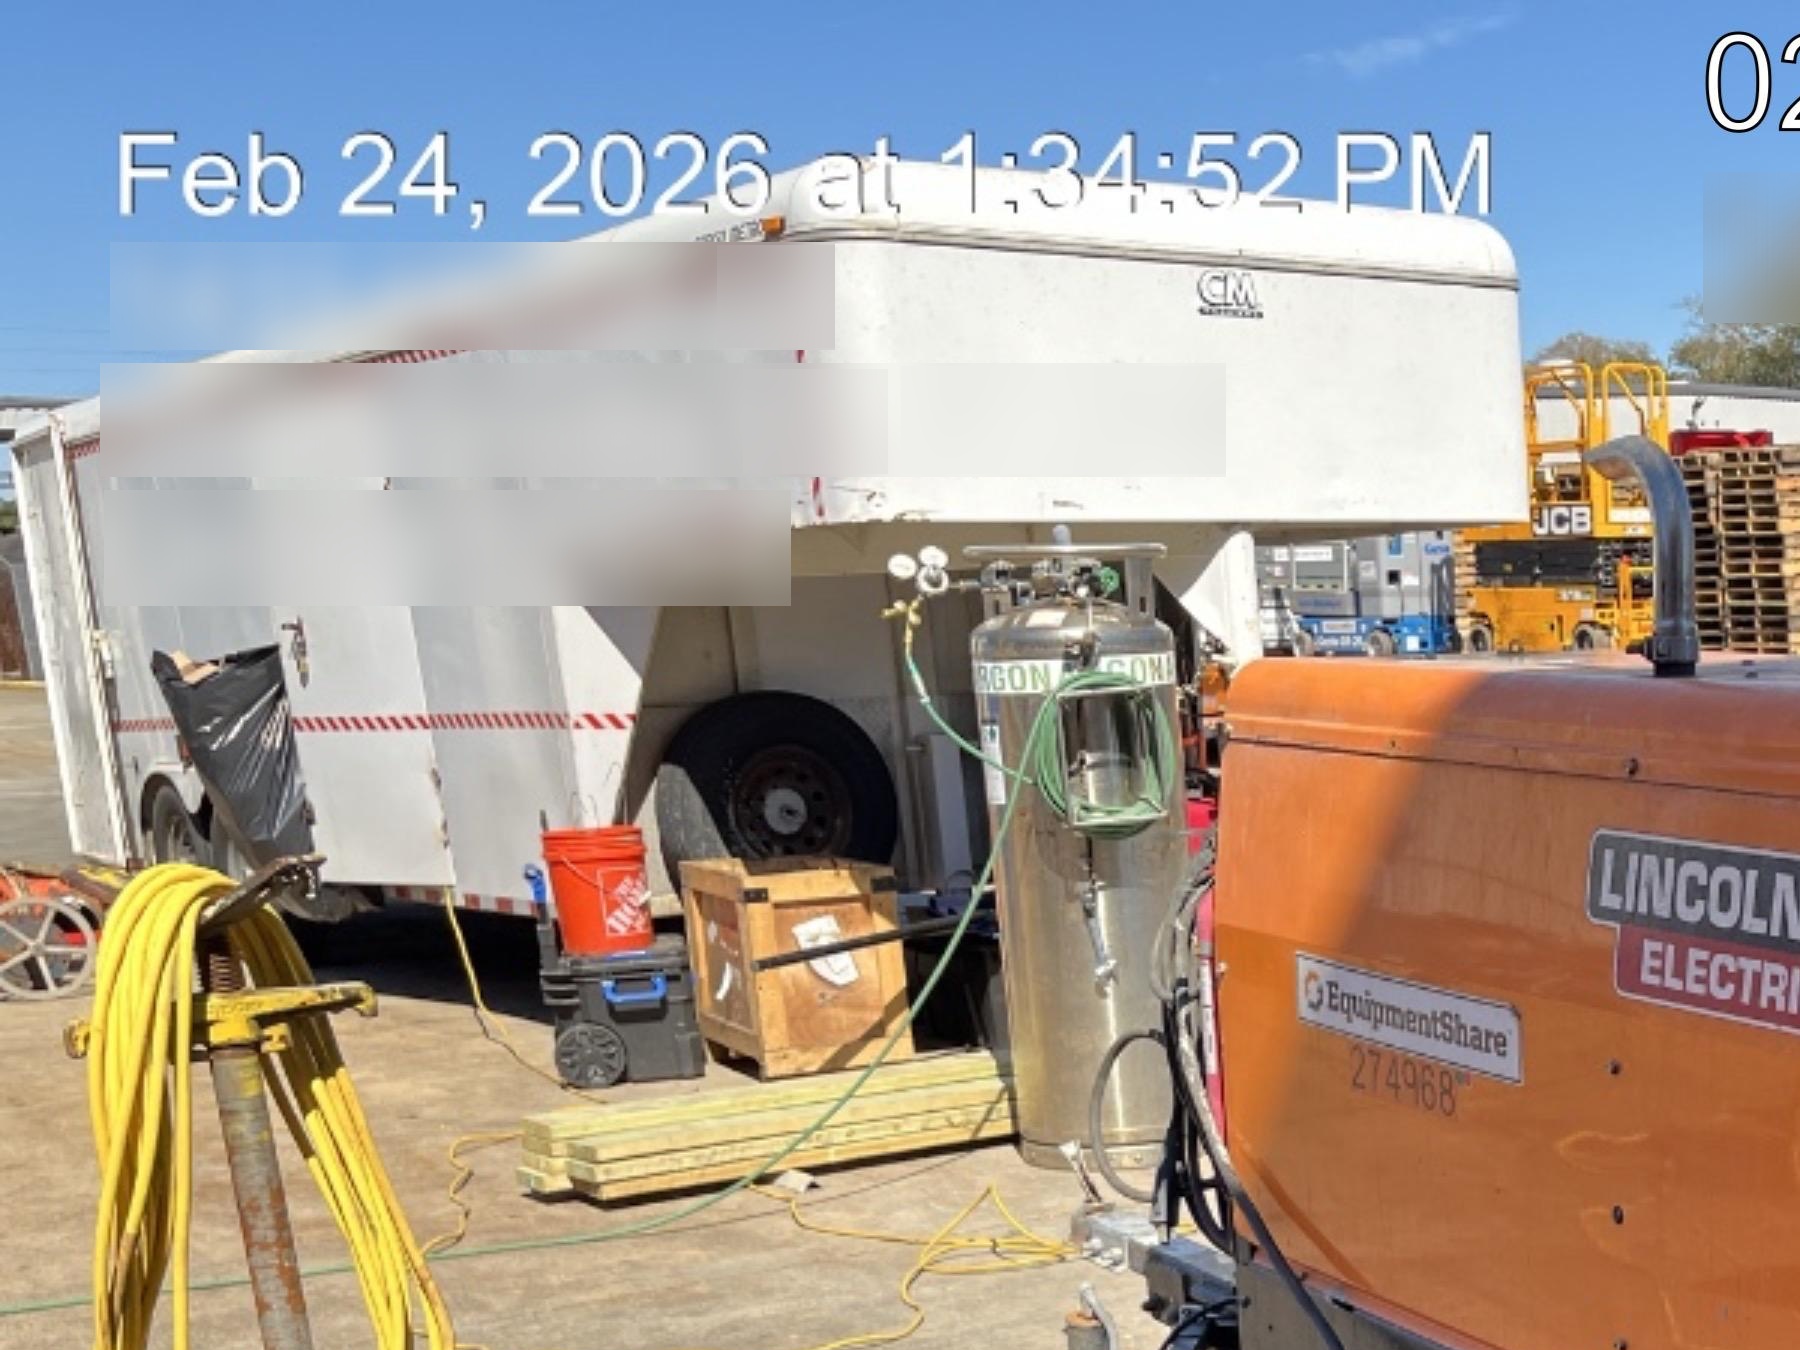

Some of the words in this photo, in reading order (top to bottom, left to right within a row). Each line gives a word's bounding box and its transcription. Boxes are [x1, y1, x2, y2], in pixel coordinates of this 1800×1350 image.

[1197, 271, 1258, 308] CM
[1531, 505, 1592, 536] JCB
[1325, 979, 1508, 1058] EquipmentShare
[1351, 1044, 1456, 1117] 274968
